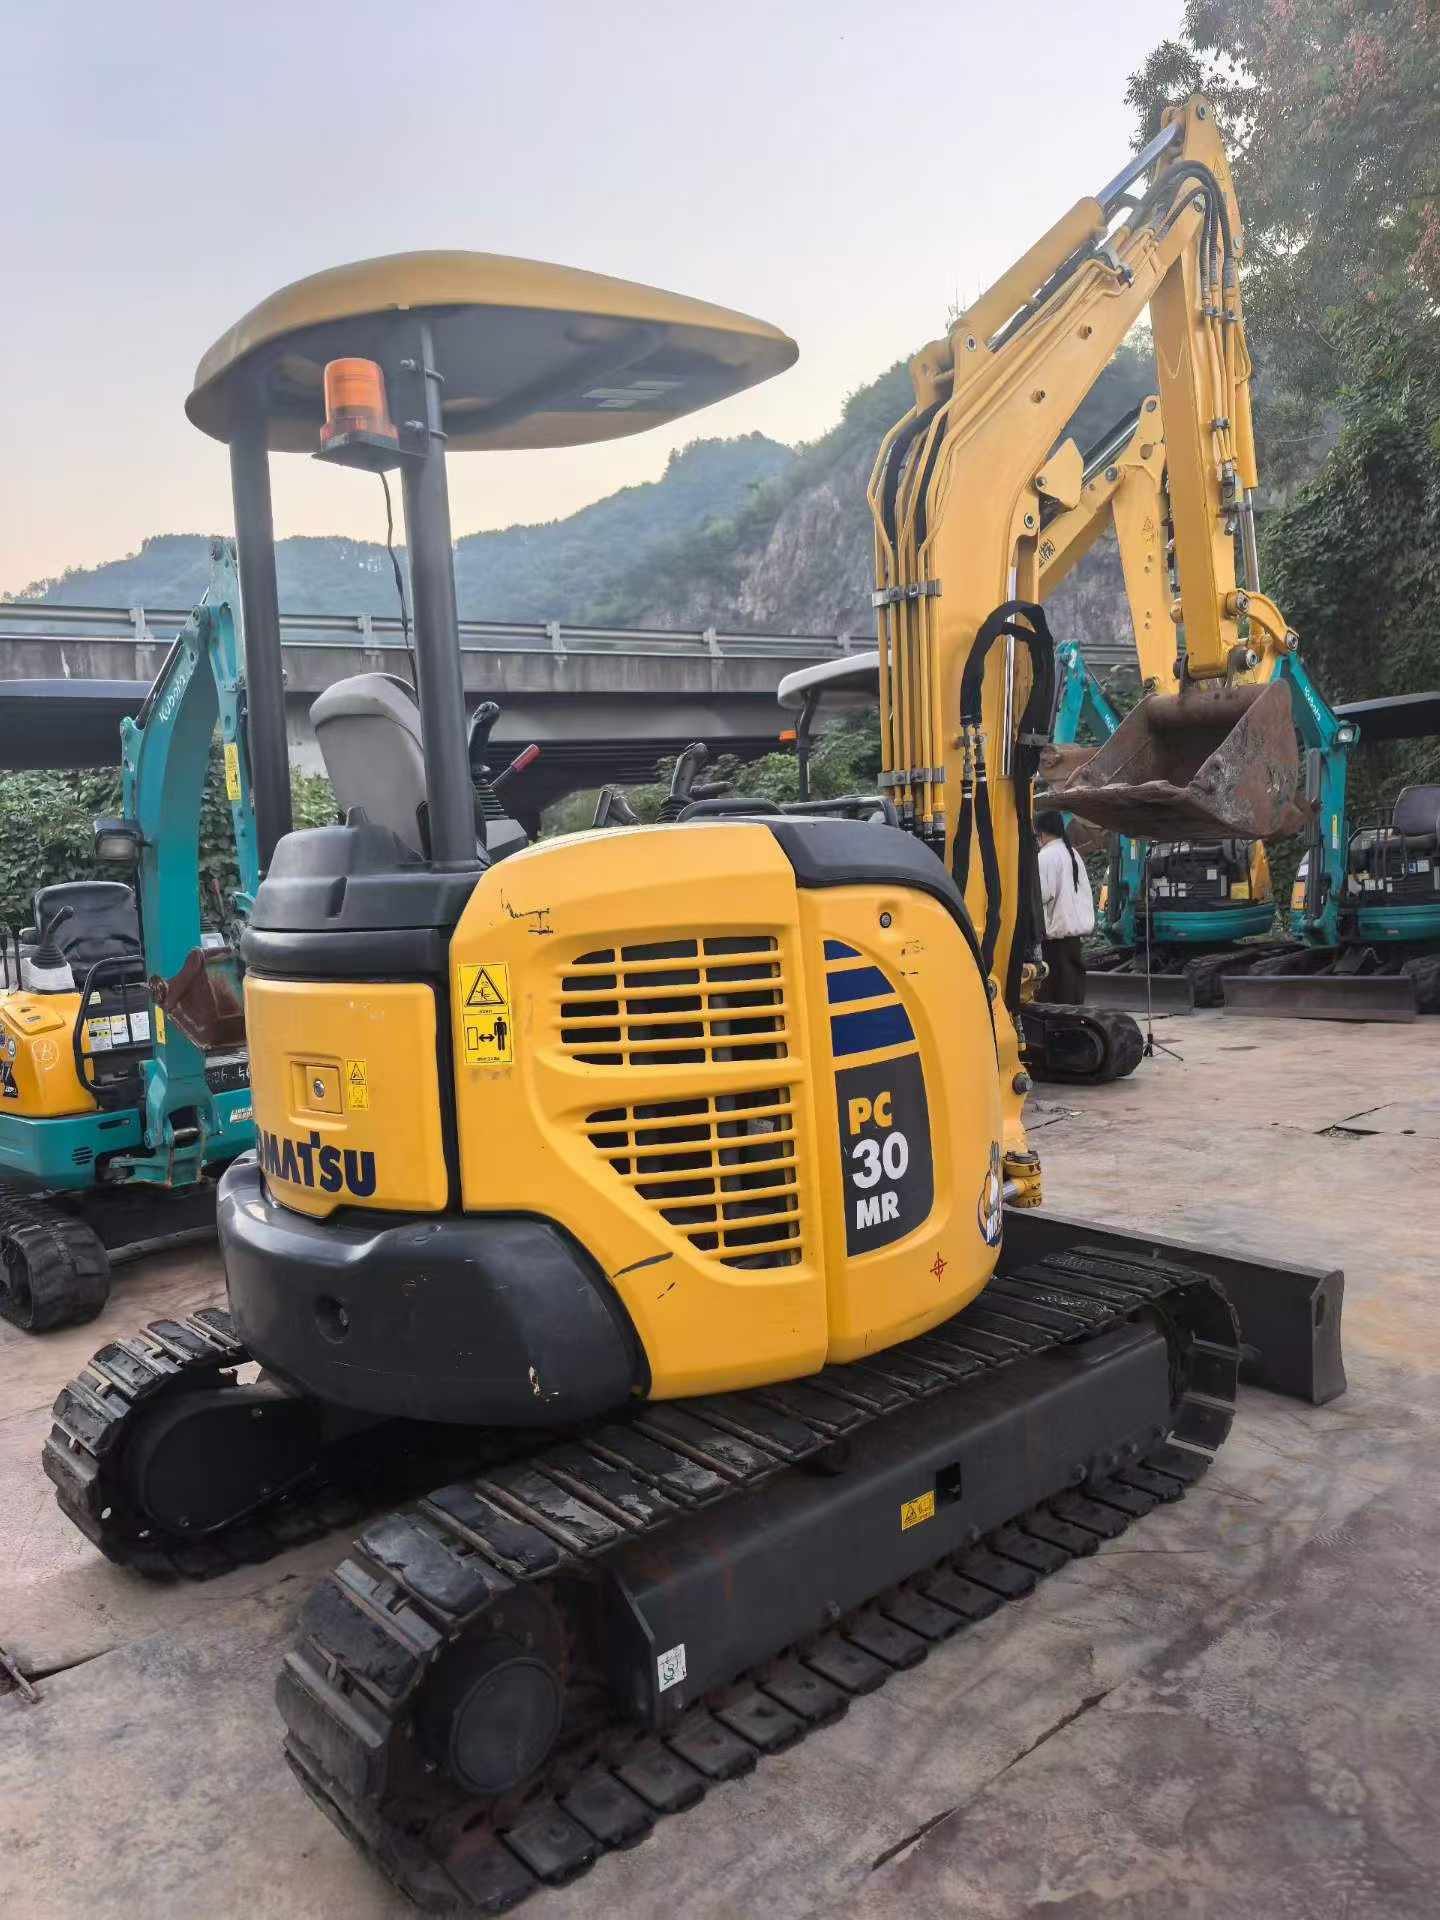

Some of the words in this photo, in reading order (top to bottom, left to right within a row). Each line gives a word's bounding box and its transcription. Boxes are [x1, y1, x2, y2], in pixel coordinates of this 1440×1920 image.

[848, 1091, 893, 1135] PC
[852, 1131, 909, 1189] 30
[856, 1191, 900, 1230] MR
